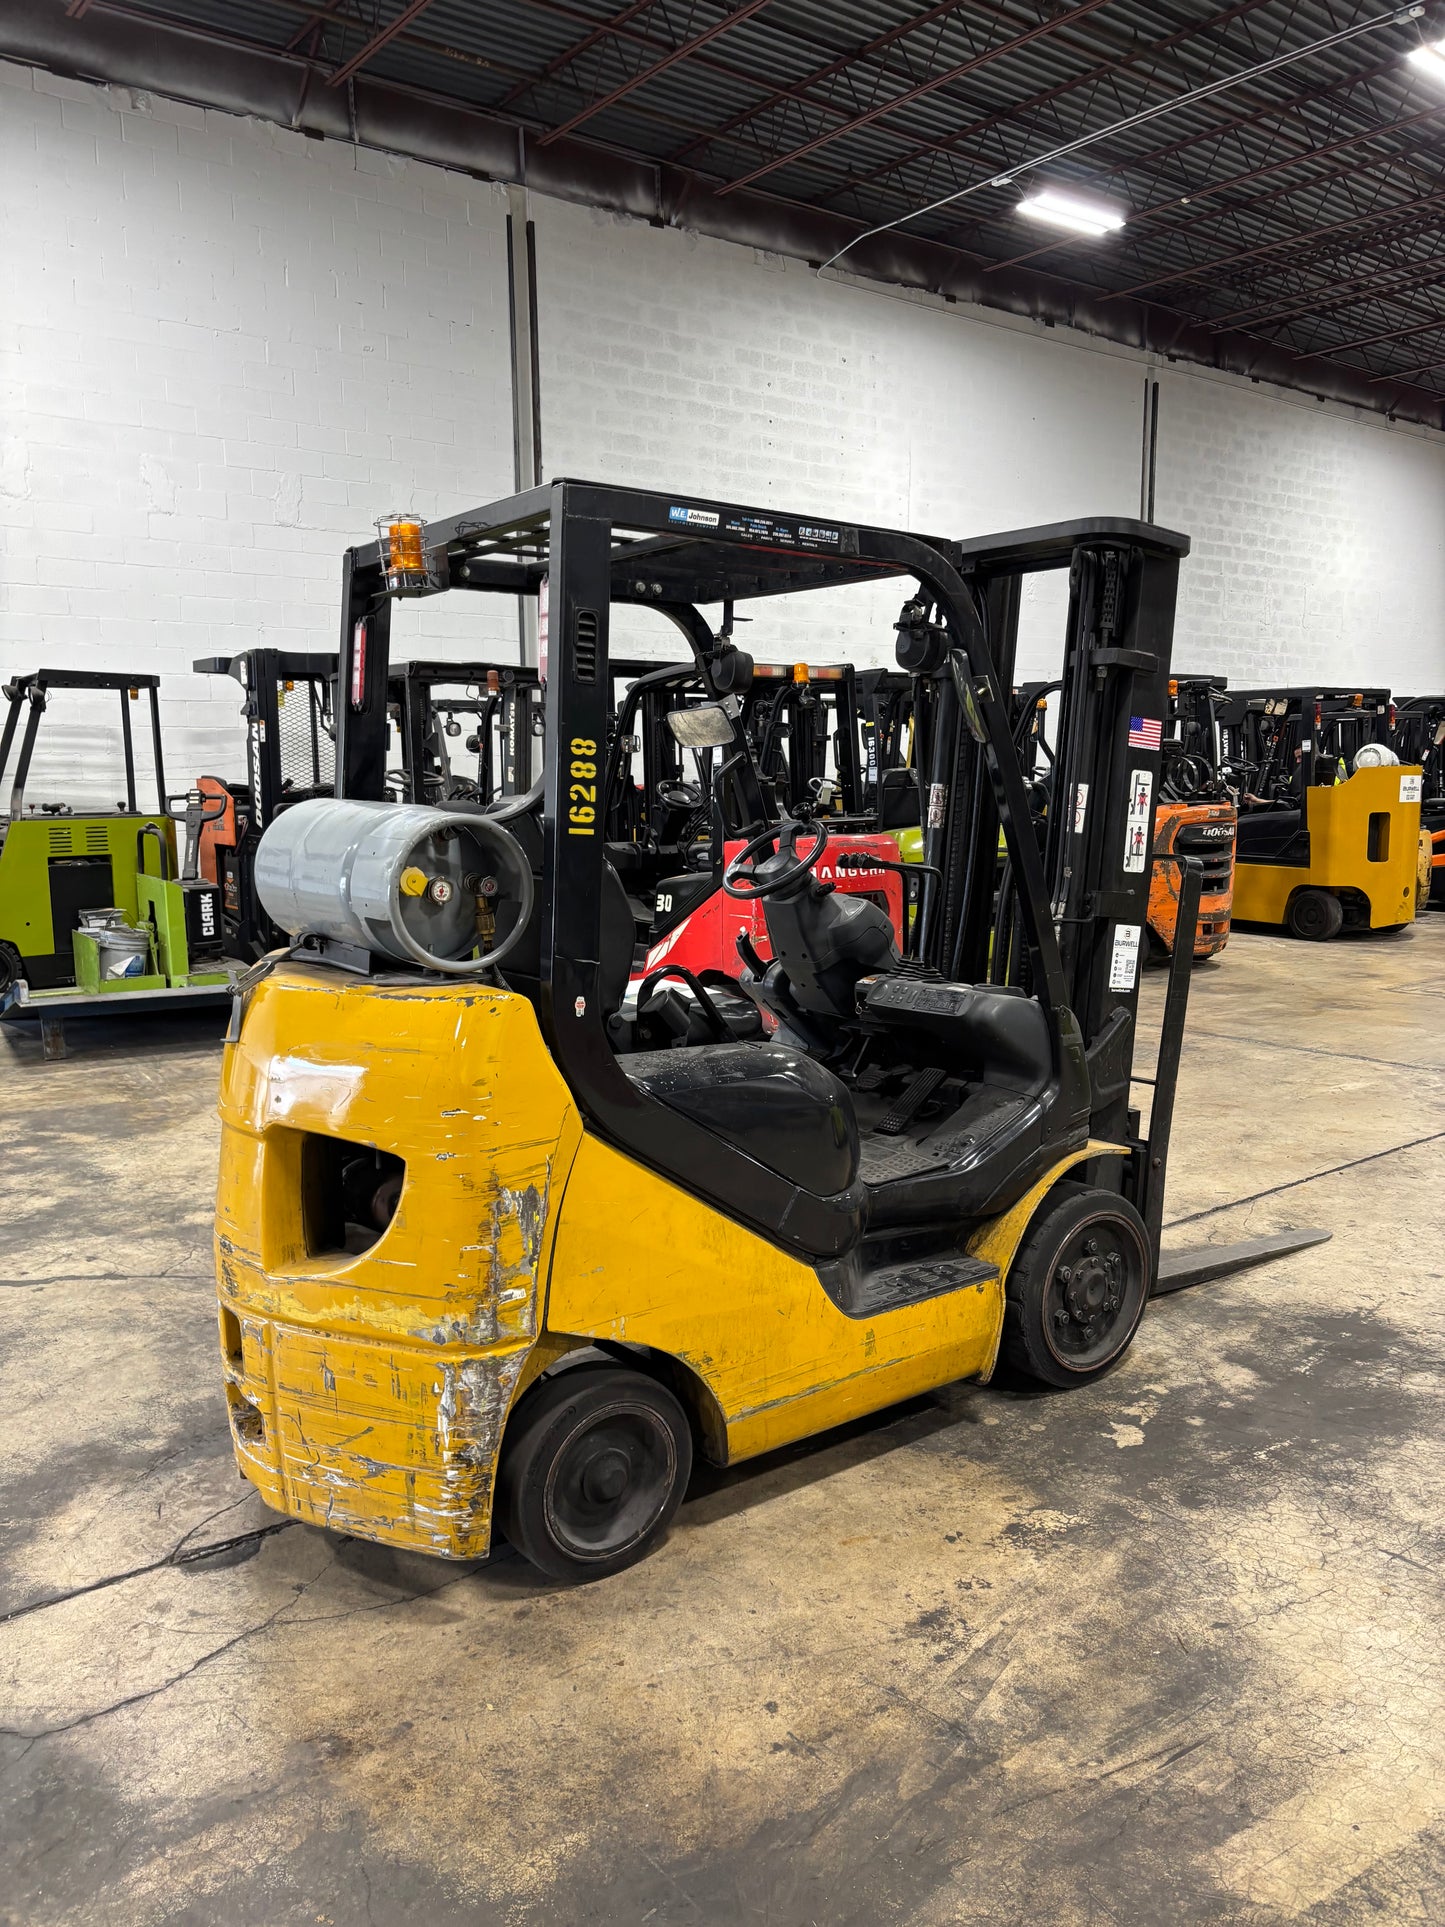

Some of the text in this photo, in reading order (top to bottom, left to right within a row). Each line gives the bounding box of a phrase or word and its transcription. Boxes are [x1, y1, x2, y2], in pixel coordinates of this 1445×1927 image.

[689, 512, 717, 523] Johnson
[867, 736, 876, 766] 16300
[251, 722, 263, 828] DOOSAN
[568, 738, 597, 835] 16288
[1203, 826, 1234, 837] DOOSA
[200, 893, 215, 936] CLARK
[656, 893, 673, 912] 30
[1114, 939, 1139, 948] BURWELL
